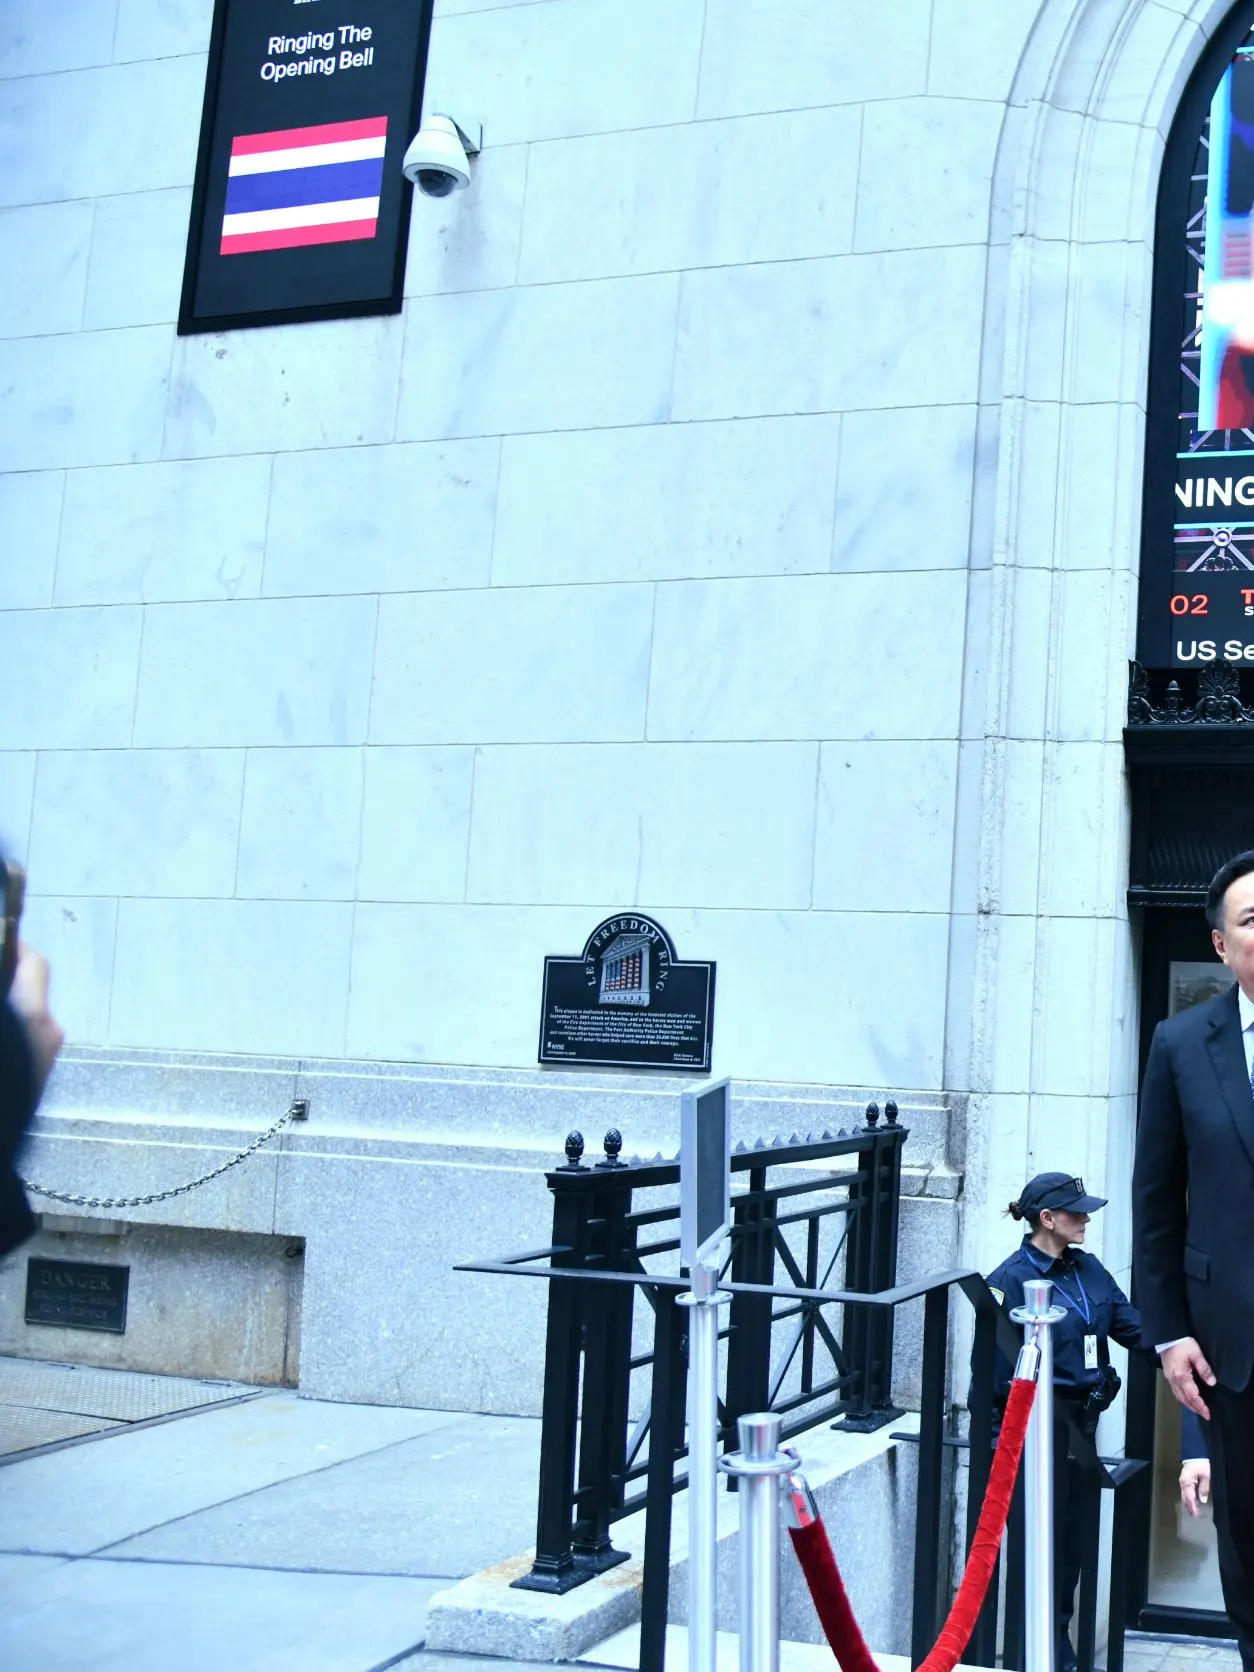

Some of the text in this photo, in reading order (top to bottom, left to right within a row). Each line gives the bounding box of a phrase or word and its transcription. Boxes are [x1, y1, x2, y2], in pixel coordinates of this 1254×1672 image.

[268, 25, 372, 55] Ringing The
[260, 47, 374, 83] Opening Bell
[1170, 594, 1209, 615] 02
[1176, 639, 1216, 661] US
[586, 920, 669, 992] LET FREEDOM RING
[40, 1269, 112, 1291] DANGER
